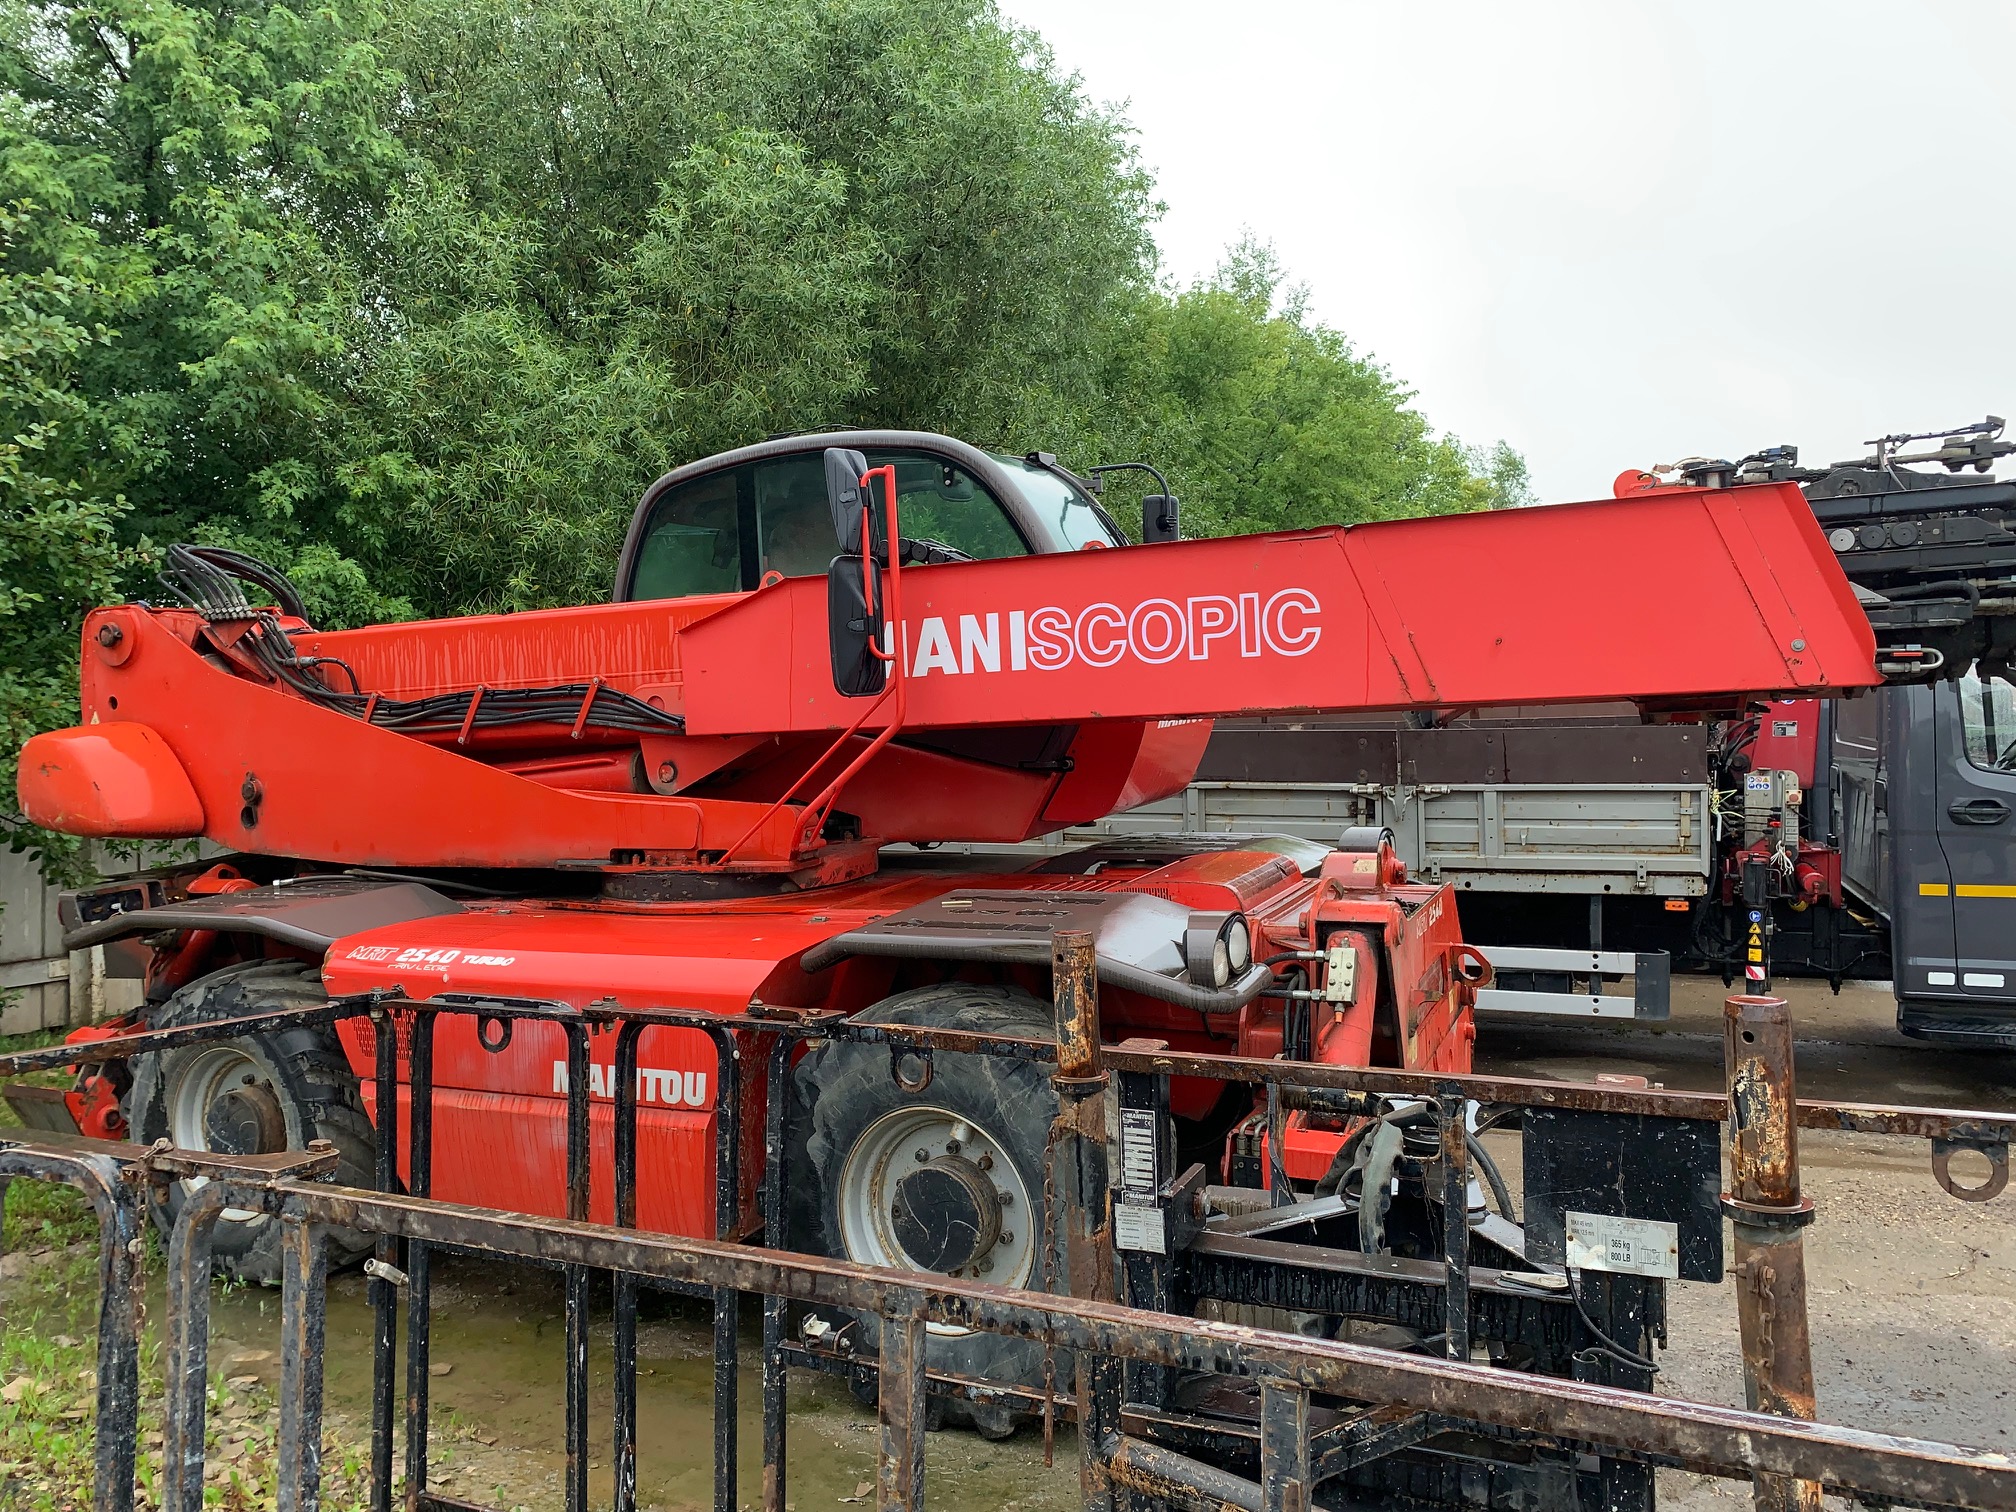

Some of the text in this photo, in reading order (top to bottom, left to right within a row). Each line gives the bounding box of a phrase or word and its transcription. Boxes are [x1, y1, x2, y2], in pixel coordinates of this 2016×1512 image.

[346, 945, 516, 967] MRT 2540 TURBO
[1610, 1239, 1631, 1251] 365 kg
[1610, 1252, 1631, 1262] 800 LB
